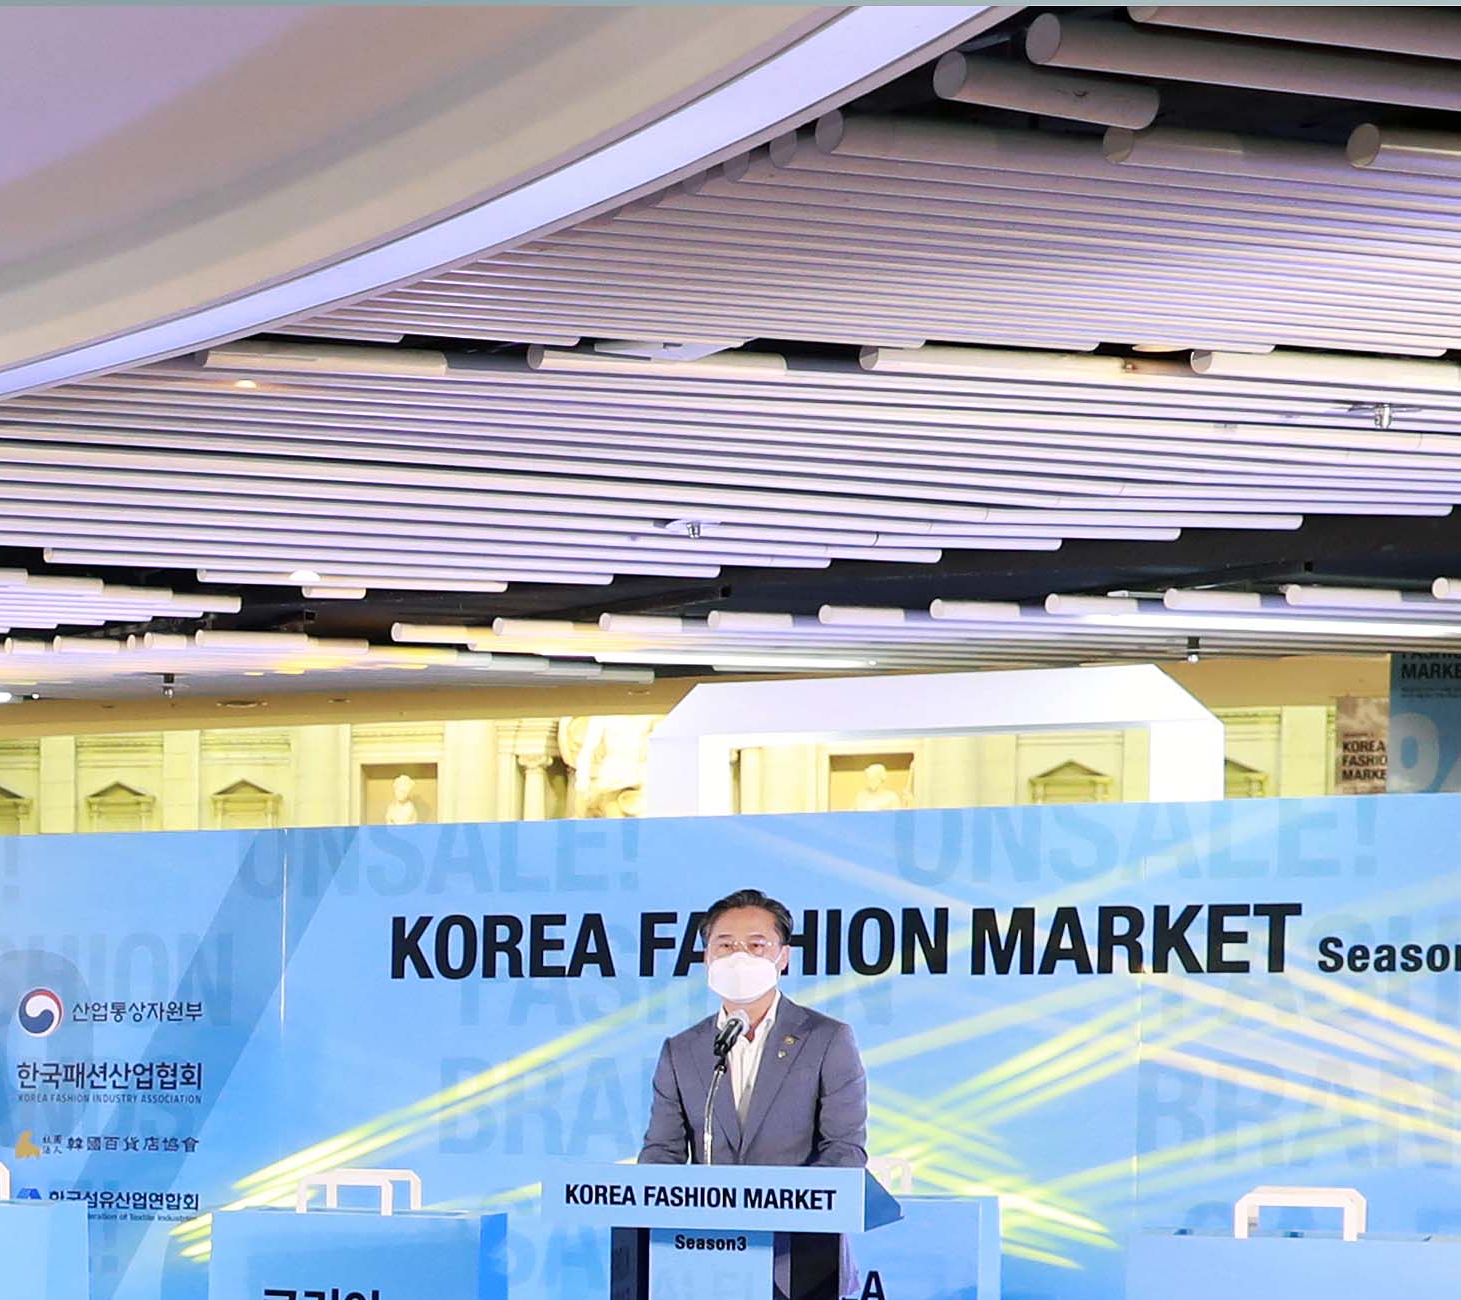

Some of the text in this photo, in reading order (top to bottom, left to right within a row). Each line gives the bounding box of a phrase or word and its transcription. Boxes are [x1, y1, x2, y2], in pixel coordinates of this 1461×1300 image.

[1343, 740, 1385, 753] KOREA
[390, 913, 616, 980] KOREA
[639, 906, 949, 979] FAHION
[970, 902, 1304, 975] MARKET
[1317, 935, 1461, 974] Seaso
[72, 1001, 203, 1023] 산업통상자원부
[17, 1062, 202, 1091] 한국패션산업협회
[18, 1094, 202, 1105] KOREA FASHION INDUSTRY ASSOCIATION
[565, 1184, 837, 1211] KOREA FASHION MARKET
[674, 1234, 747, 1252] Season3
